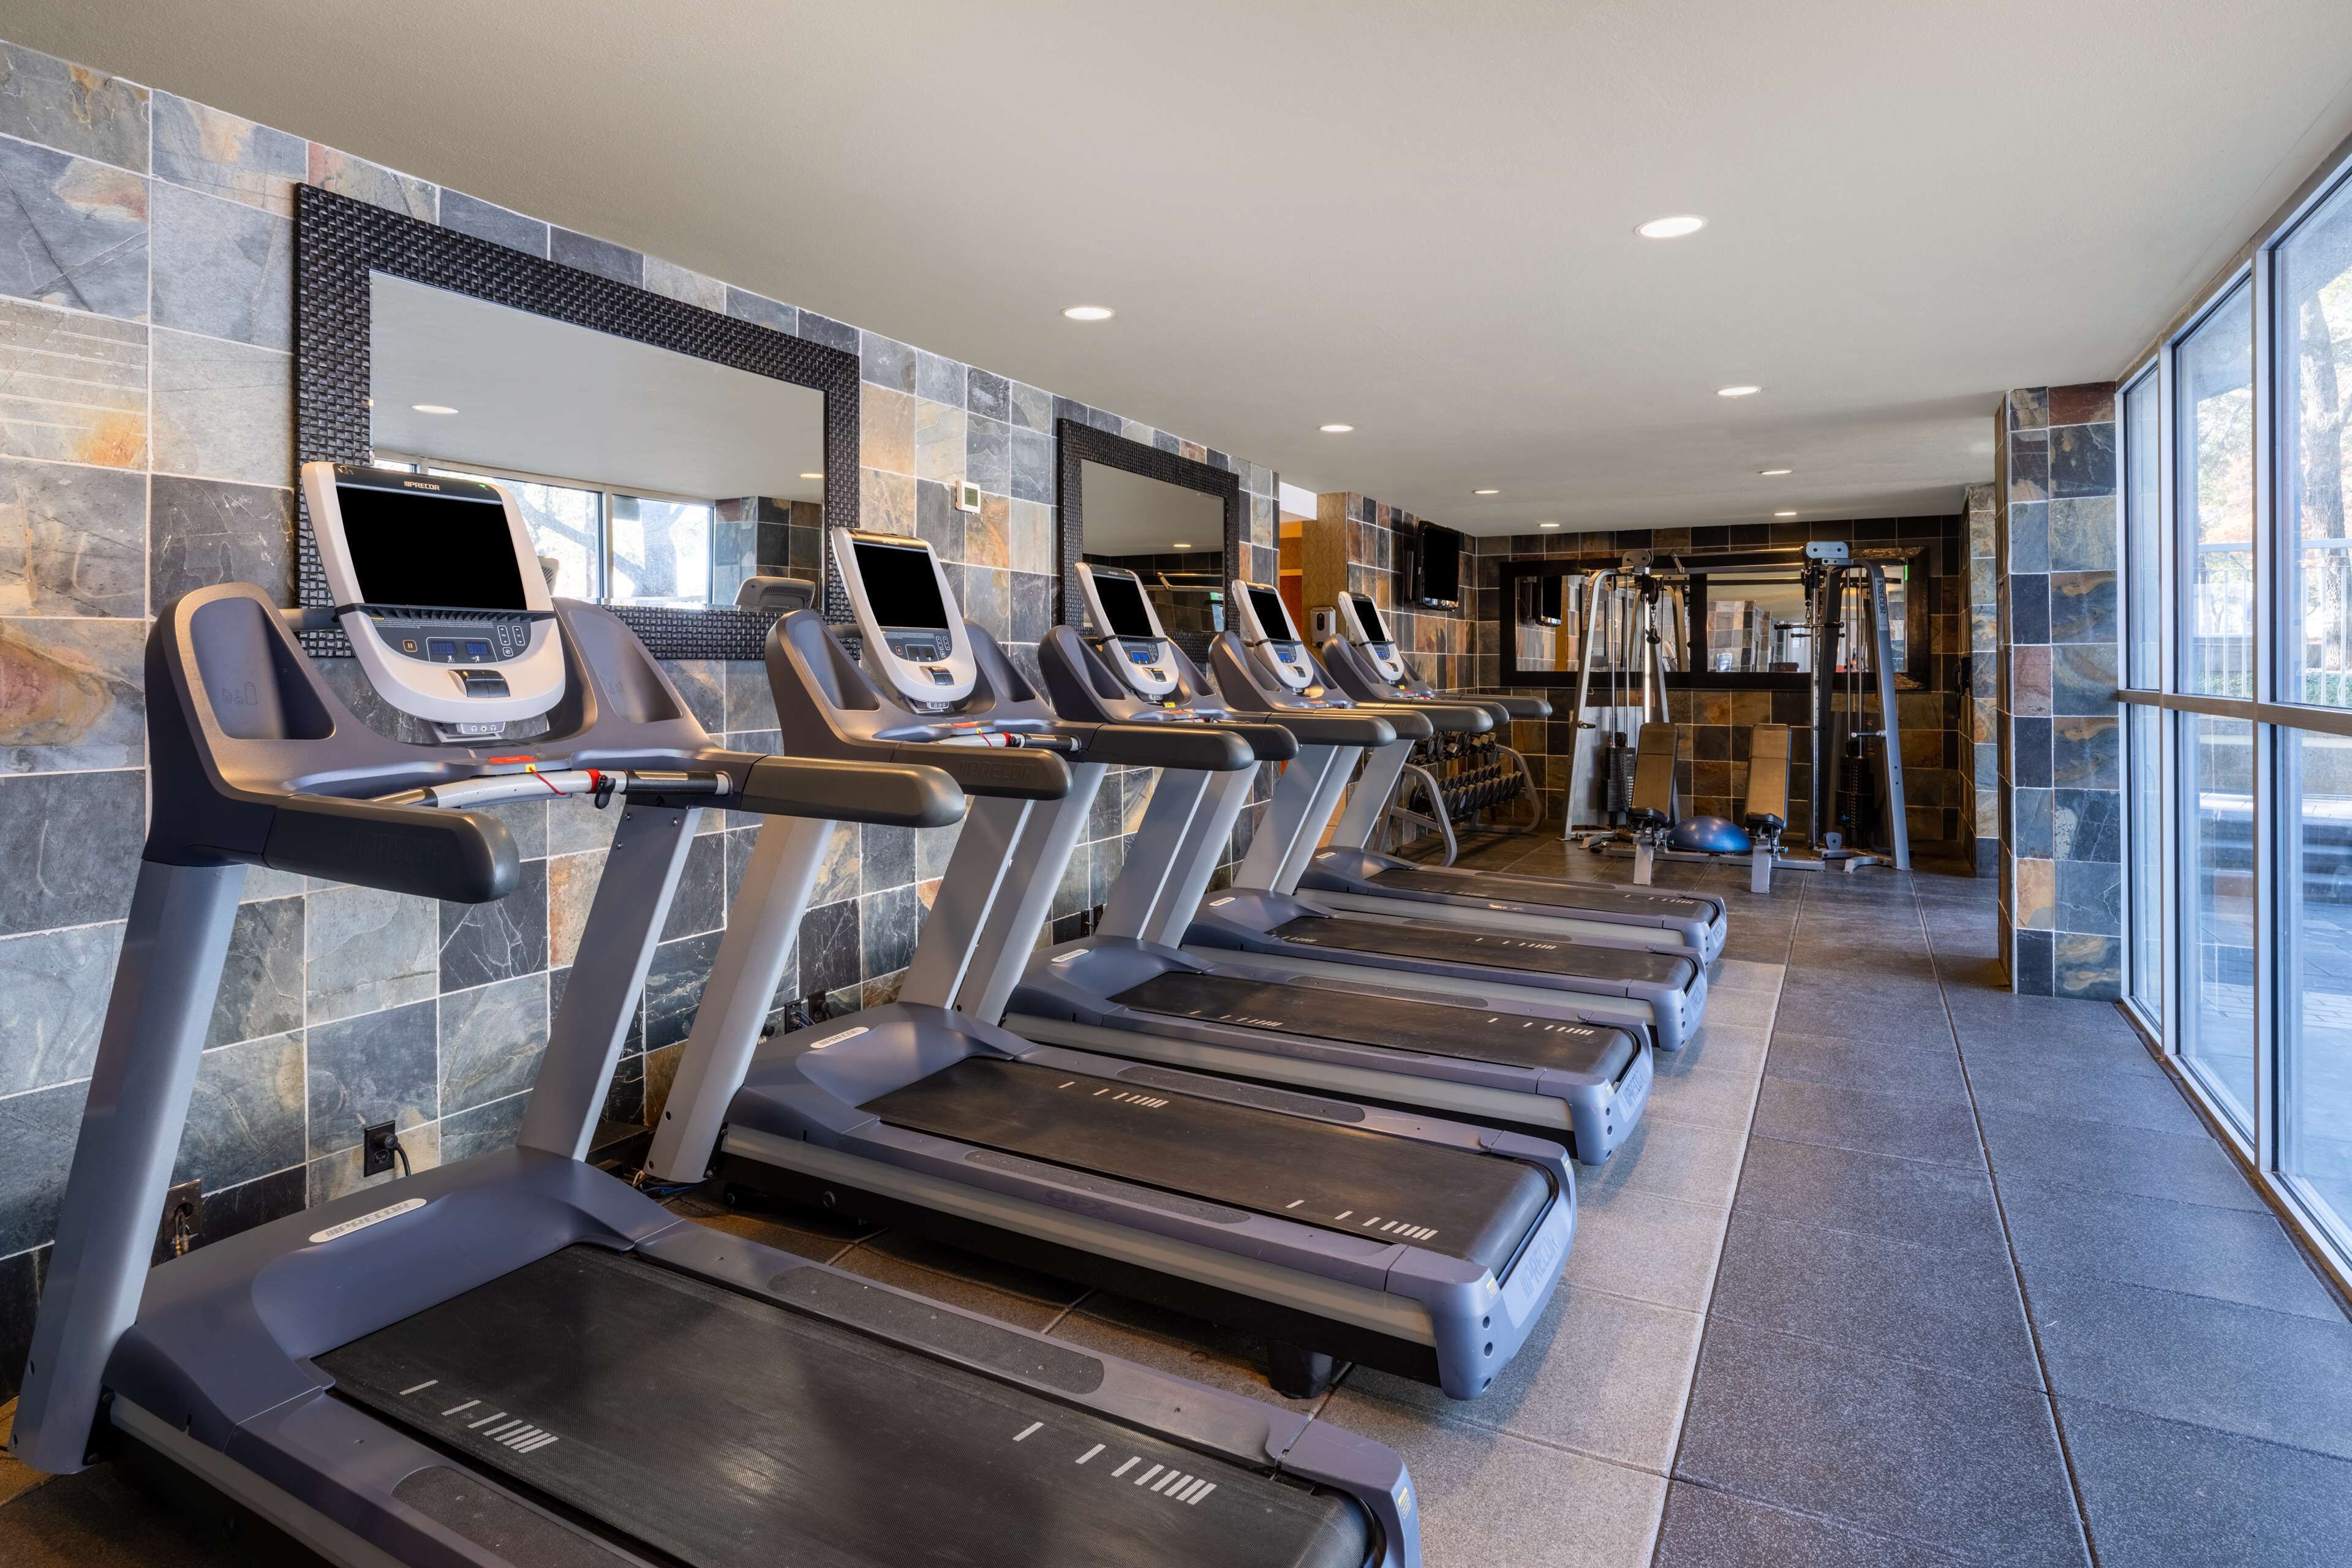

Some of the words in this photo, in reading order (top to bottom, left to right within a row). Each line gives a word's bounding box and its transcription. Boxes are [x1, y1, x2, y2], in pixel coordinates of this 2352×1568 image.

[409, 481, 440, 491] PRECOR
[1877, 580, 1887, 614] PRECOR
[337, 1202, 409, 1231] PRECOR
